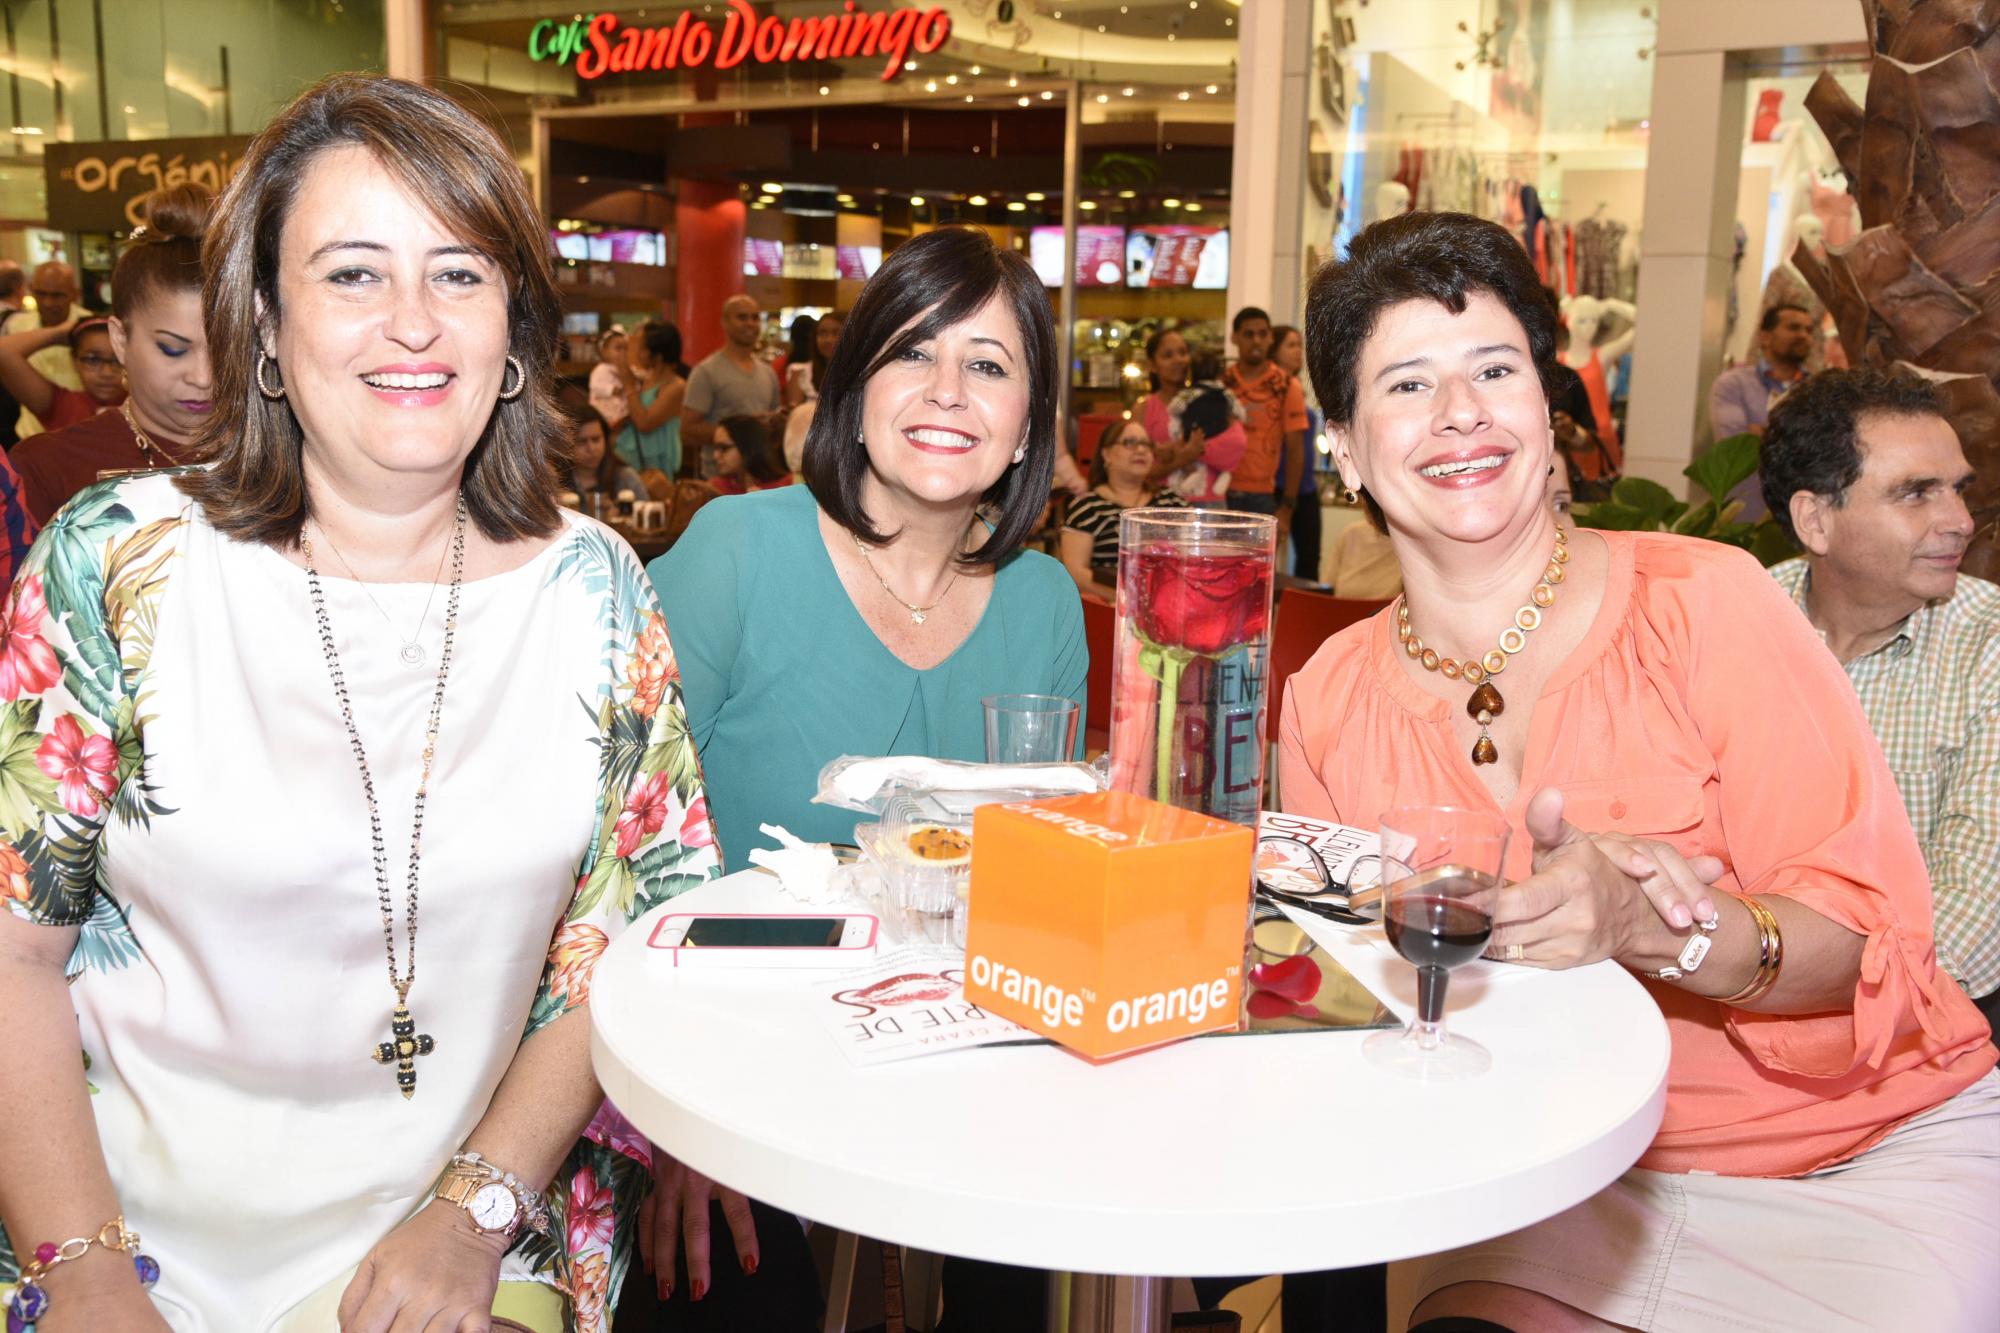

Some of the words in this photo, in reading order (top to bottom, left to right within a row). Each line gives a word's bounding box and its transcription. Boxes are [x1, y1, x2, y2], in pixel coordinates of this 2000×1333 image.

[576, 10, 712, 79] Santo
[714, 0, 950, 81] Domingo
[1003, 803, 1128, 842] orange
[845, 1016, 903, 1042] DE
